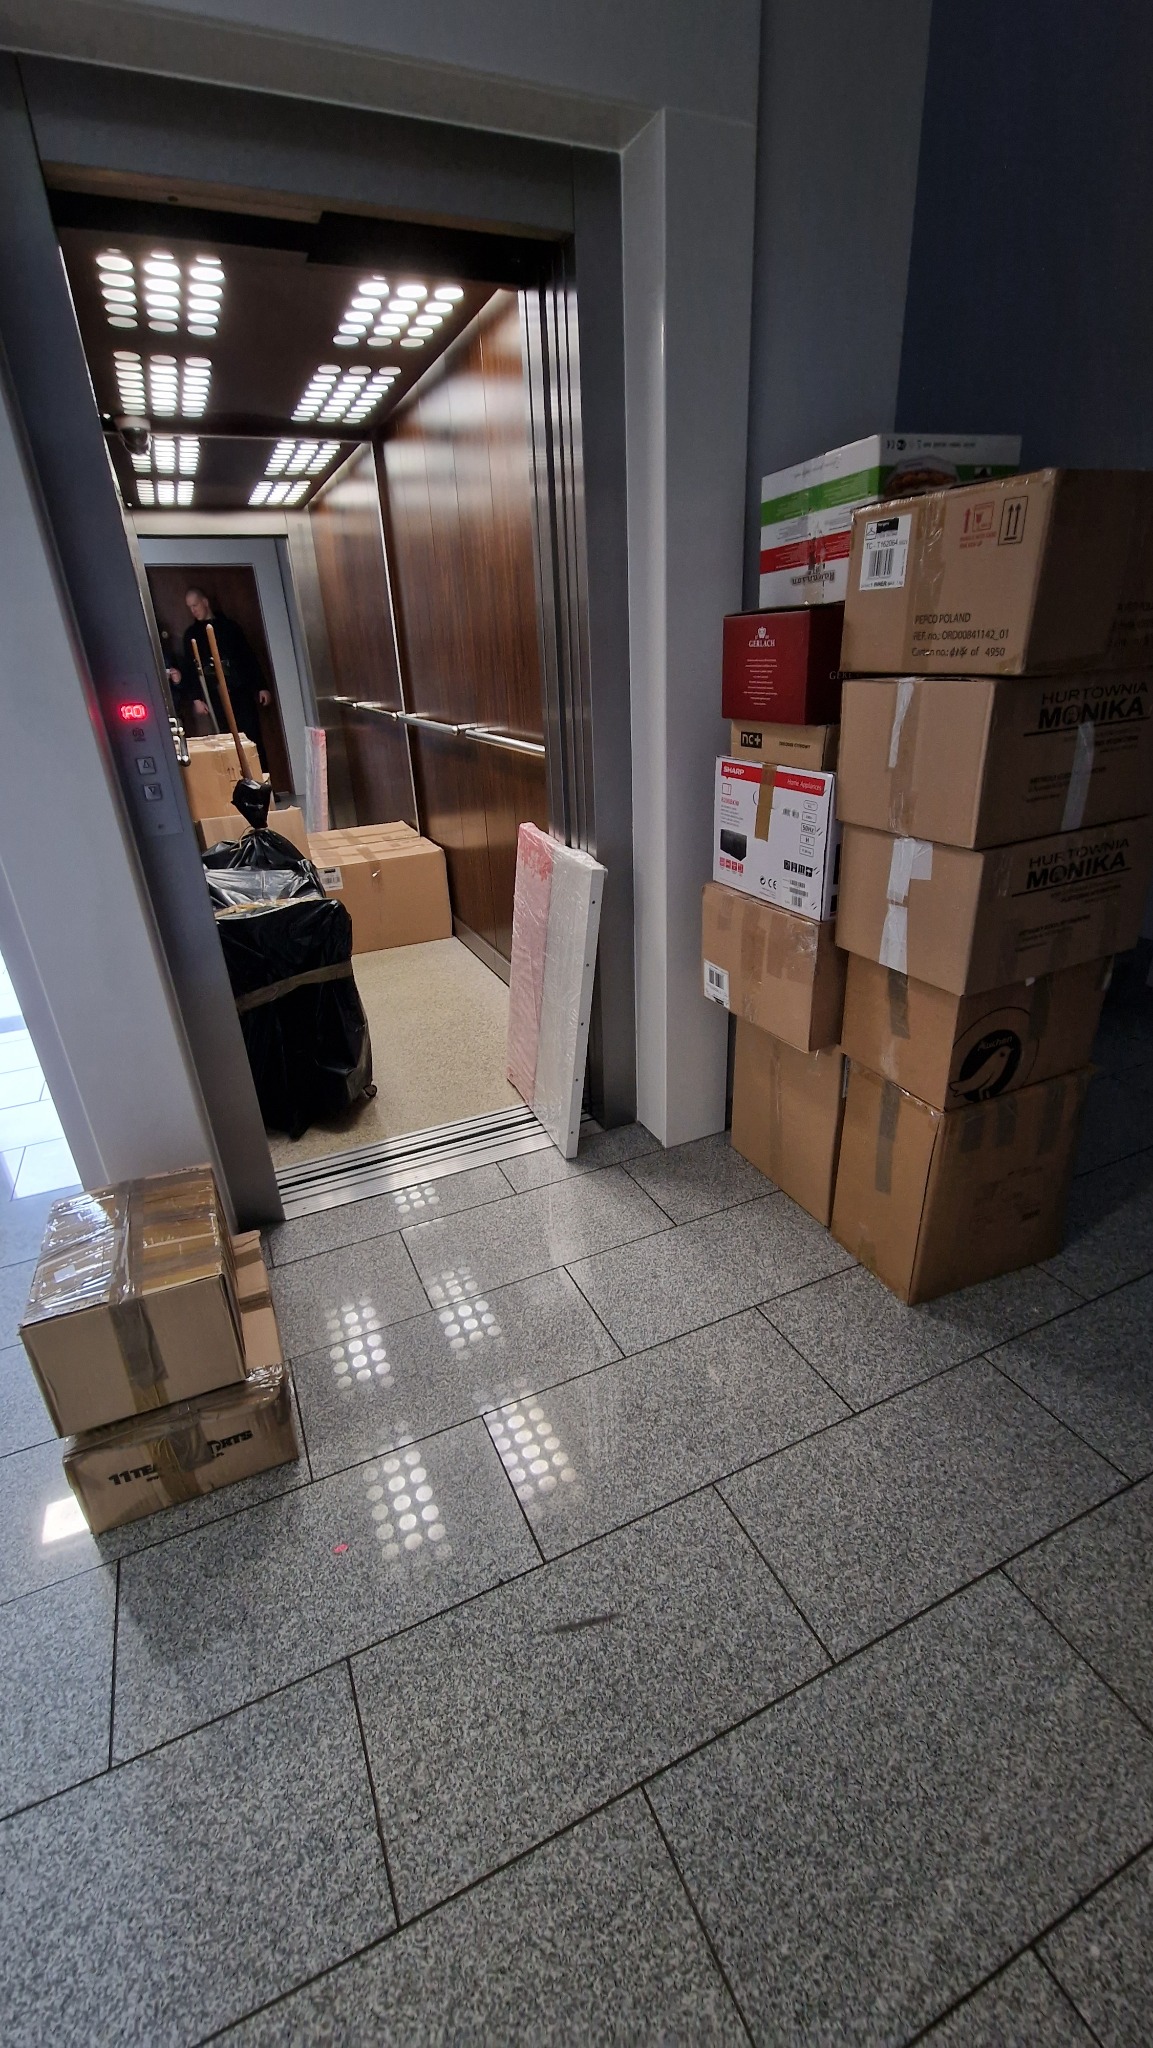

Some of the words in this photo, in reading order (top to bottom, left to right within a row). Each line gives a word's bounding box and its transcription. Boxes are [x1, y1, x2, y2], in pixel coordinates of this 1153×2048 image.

[914, 614, 938, 624] PEPCO
[939, 612, 971, 623] POLAND
[748, 639, 776, 648] GERLACH
[970, 646, 980, 656] of
[985, 647, 1006, 656] 4950
[1042, 681, 1148, 704] HURTOWNIA
[1038, 696, 1144, 729] MONIKA
[741, 733, 762, 746] nc+
[723, 765, 745, 776] SHARP
[787, 778, 800, 787] Home
[800, 780, 822, 792] Appliances
[1029, 838, 1129, 868] HURTOWNIA
[1026, 851, 1125, 889] MONIKA
[977, 1035, 1013, 1051] Auchan
